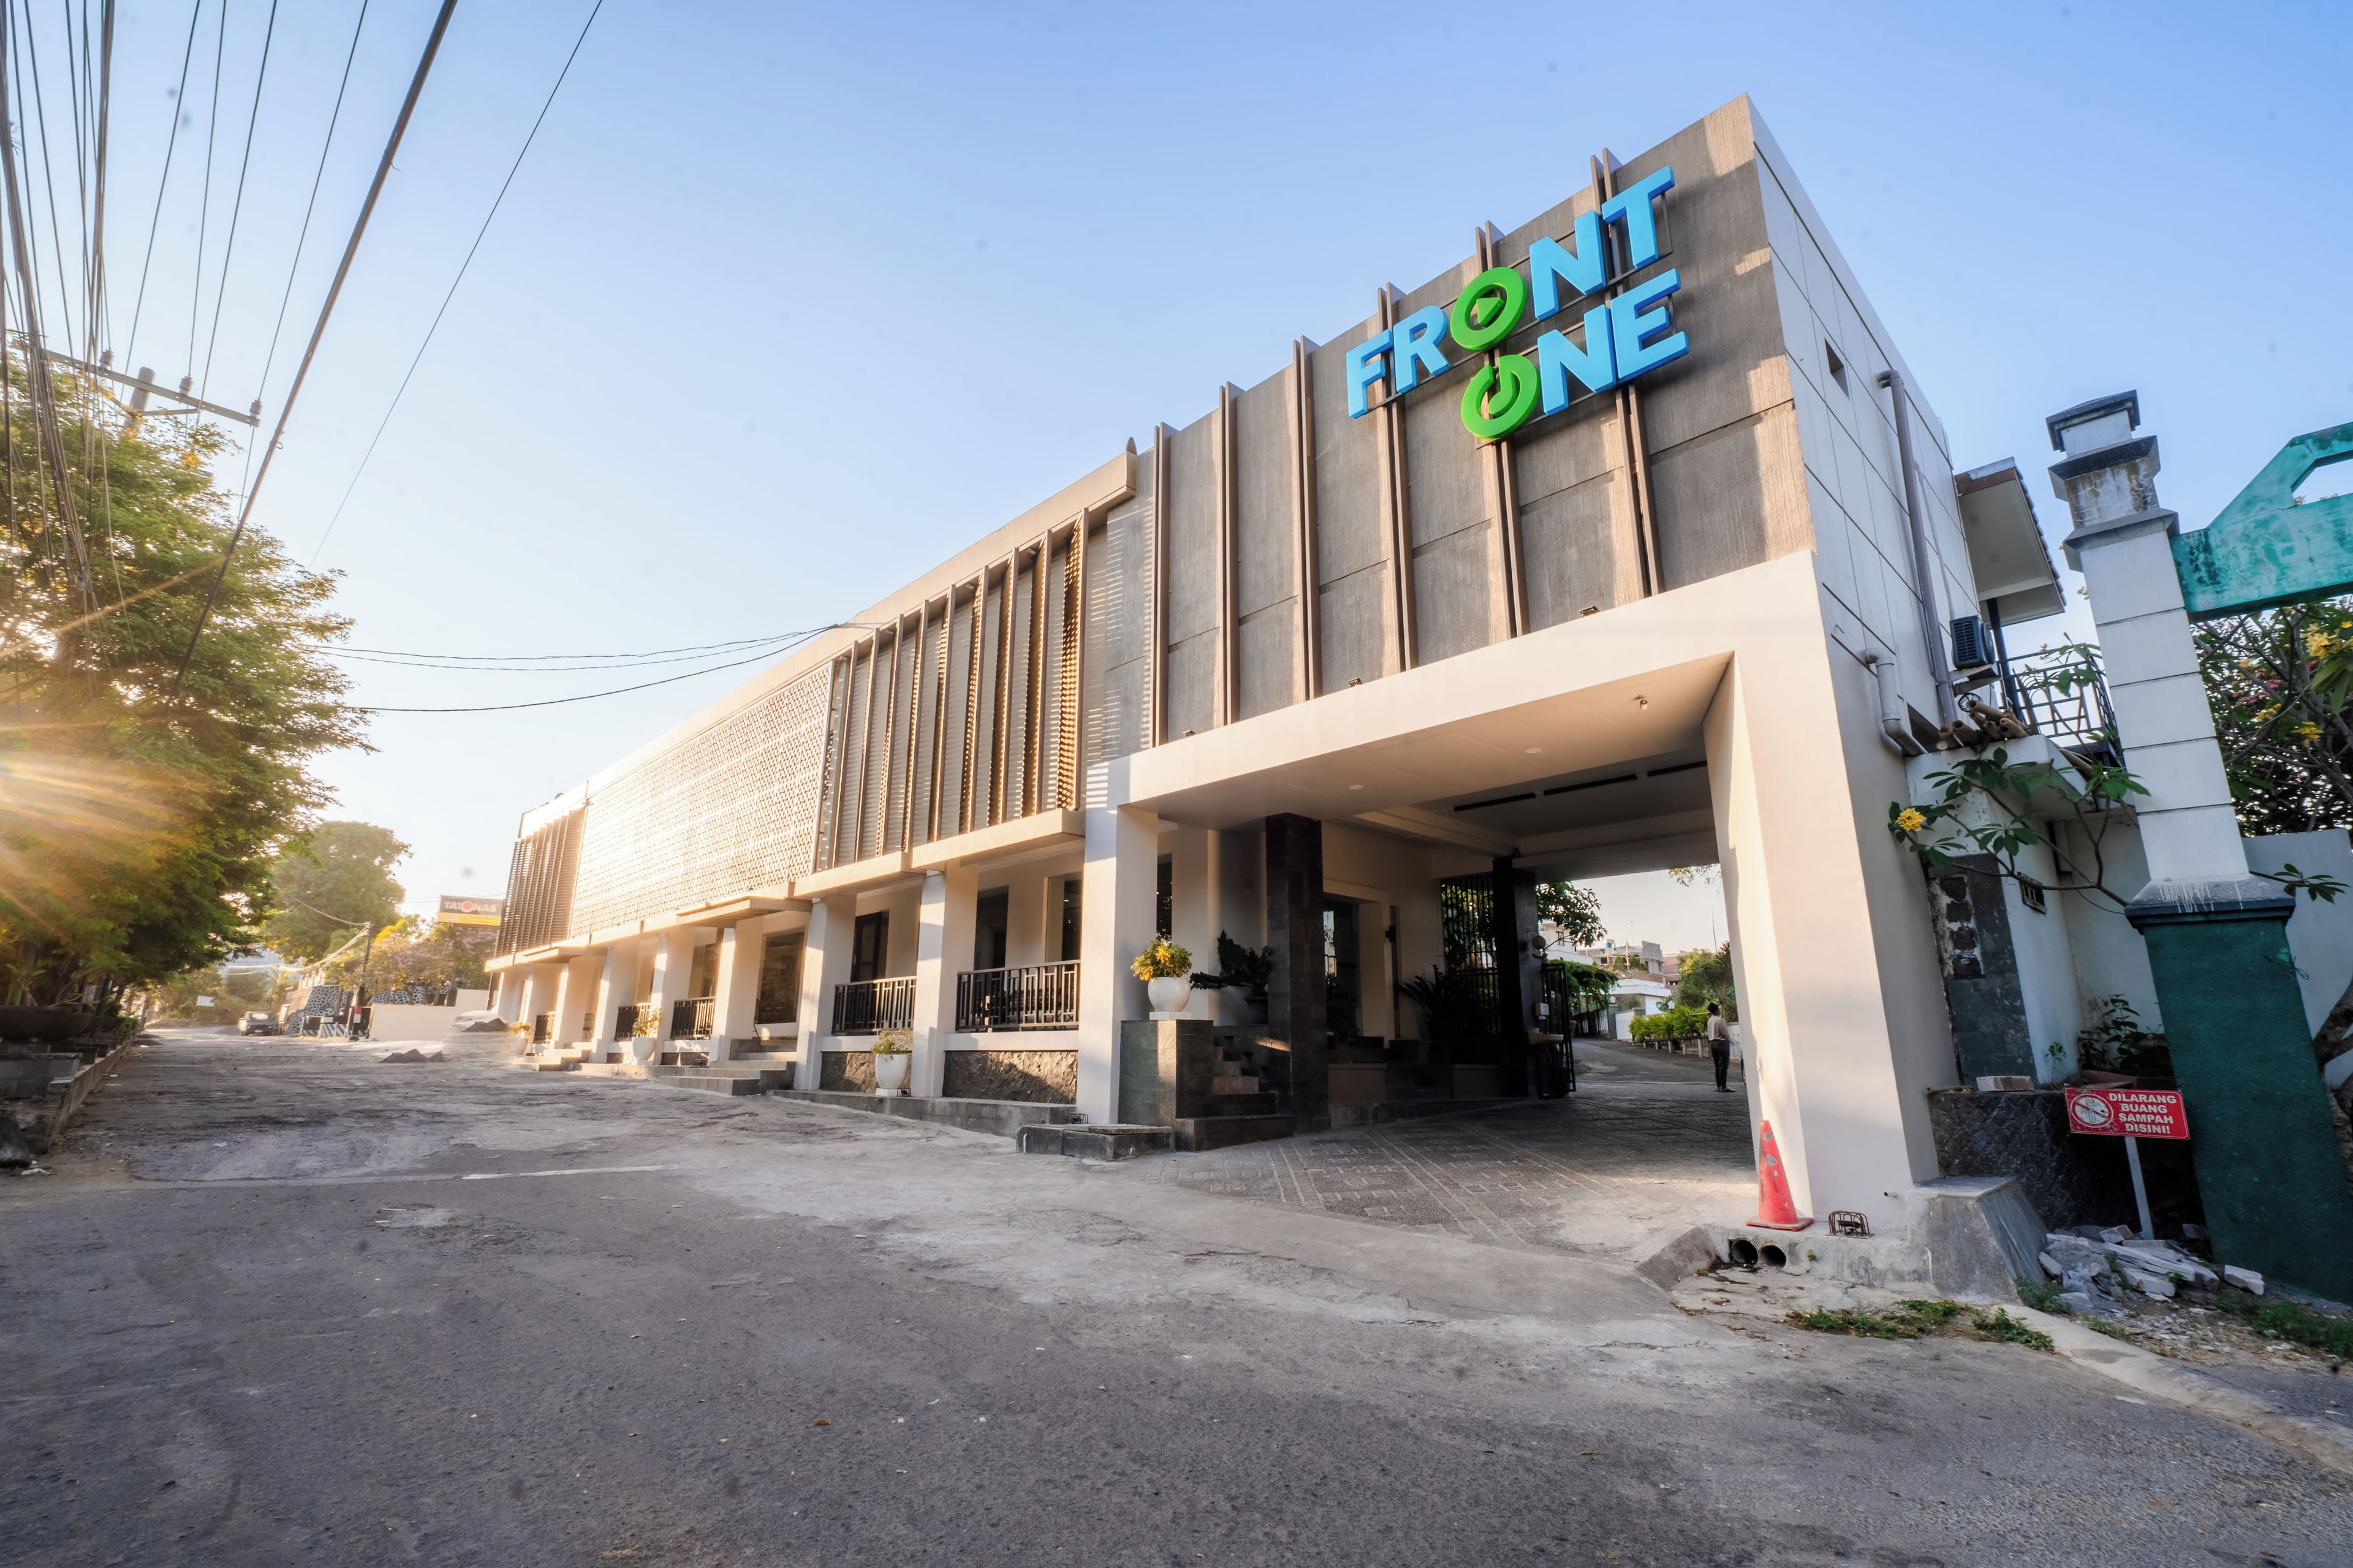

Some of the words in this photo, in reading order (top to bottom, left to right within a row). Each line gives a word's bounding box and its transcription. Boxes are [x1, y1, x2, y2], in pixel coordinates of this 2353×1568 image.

[1346, 164, 1675, 419] FRONT
[1461, 268, 1691, 439] ONE
[2109, 1093, 2177, 1104] DILARANG
[2120, 1103, 2168, 1113] BUANG
[2118, 1113, 2174, 1124] SAMPAH
[2125, 1123, 2170, 1134] DISINI!
